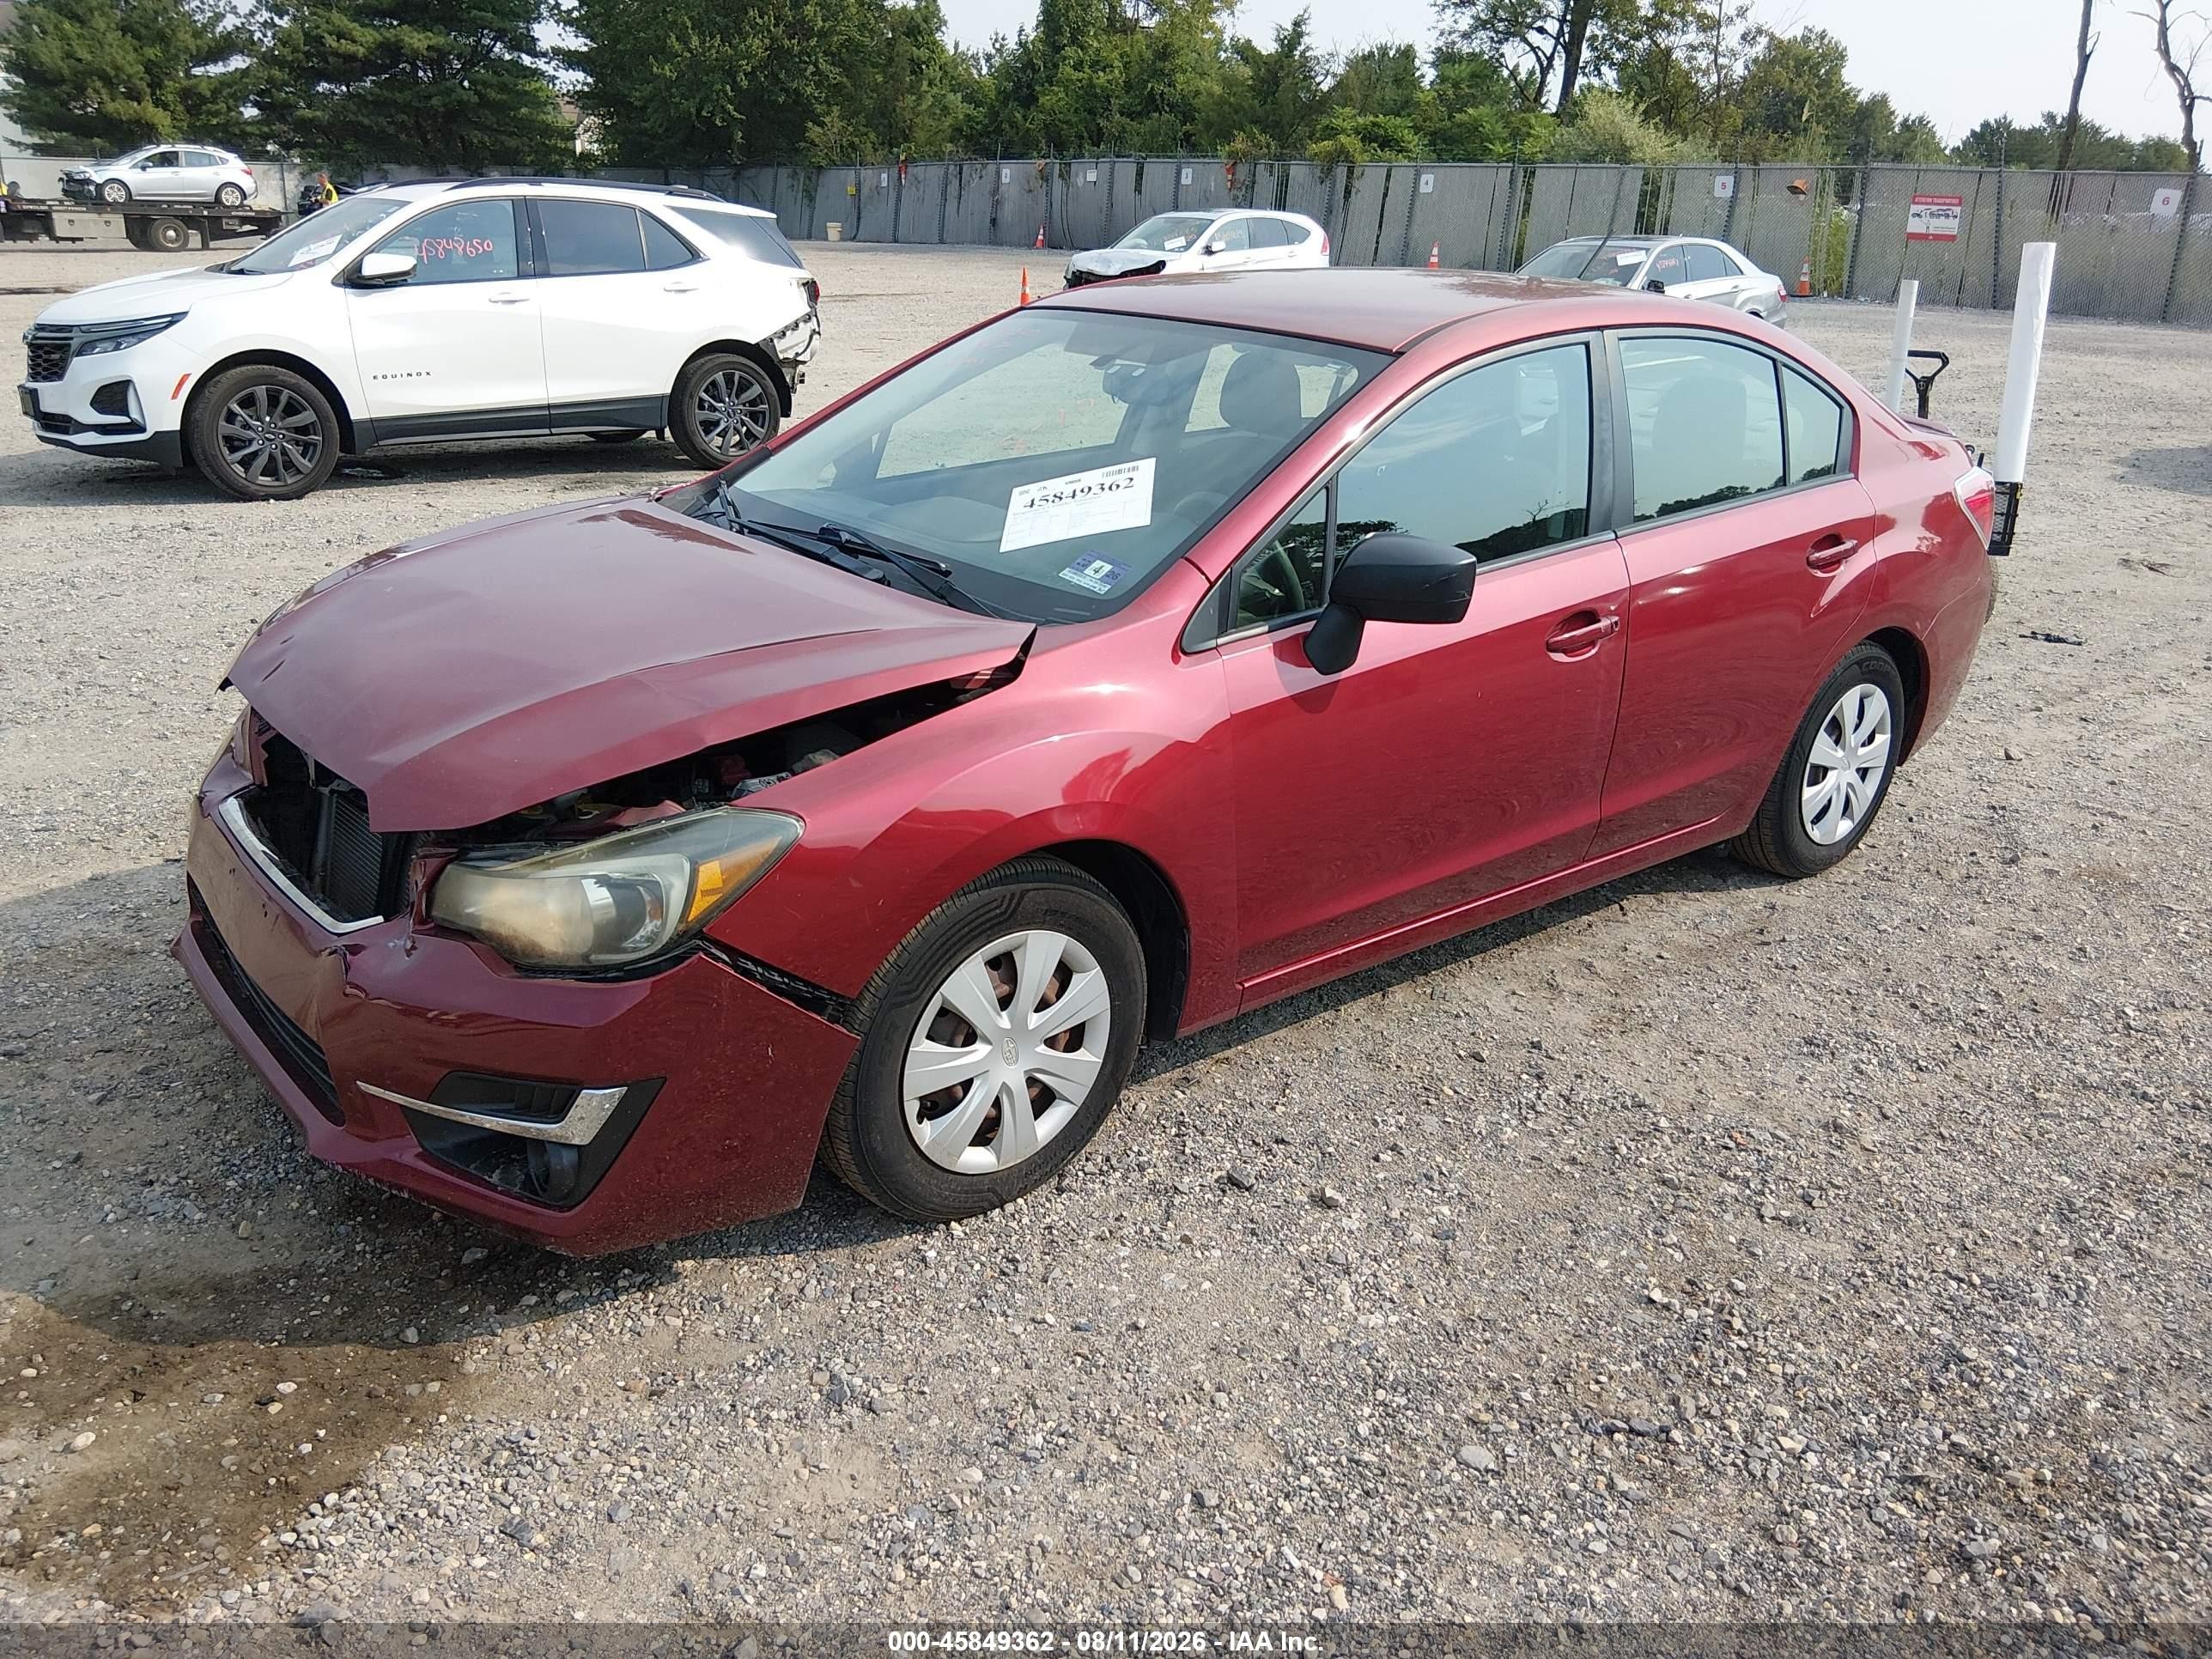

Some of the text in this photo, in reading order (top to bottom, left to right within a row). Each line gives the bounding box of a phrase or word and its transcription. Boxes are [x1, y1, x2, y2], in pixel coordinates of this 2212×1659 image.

[2162, 197, 2170, 206] 6
[373, 371, 431, 380] EQUINOX
[1023, 477, 1134, 509] 45849362
[1092, 565, 1105, 575] 4
